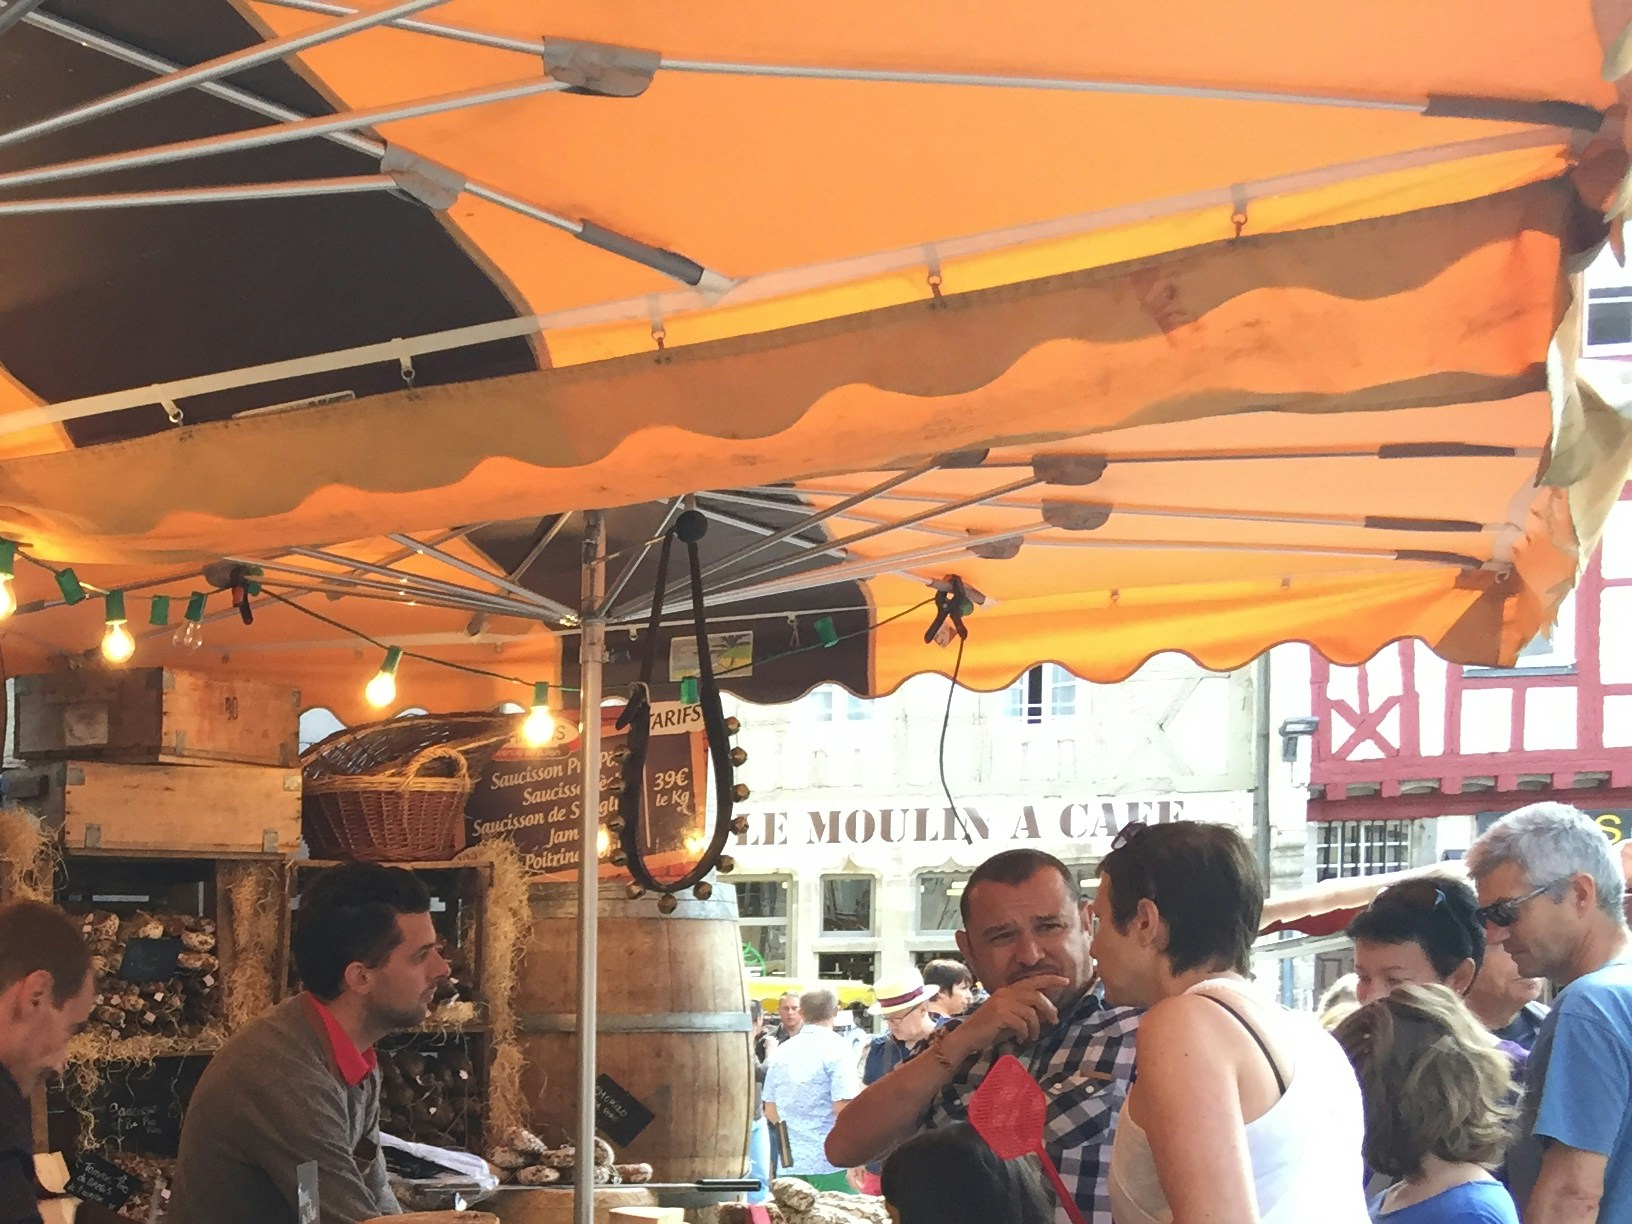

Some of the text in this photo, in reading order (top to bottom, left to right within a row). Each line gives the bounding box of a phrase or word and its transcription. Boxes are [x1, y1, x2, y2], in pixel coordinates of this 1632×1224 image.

[490, 763, 563, 791] Saucisson
[654, 767, 690, 791] 39€
[656, 790, 692, 815] le Kg
[472, 810, 545, 837] Saucisson
[548, 804, 567, 823] de
[734, 811, 788, 846] LE
[806, 805, 990, 845] MOULIN
[1011, 805, 1043, 840] A
